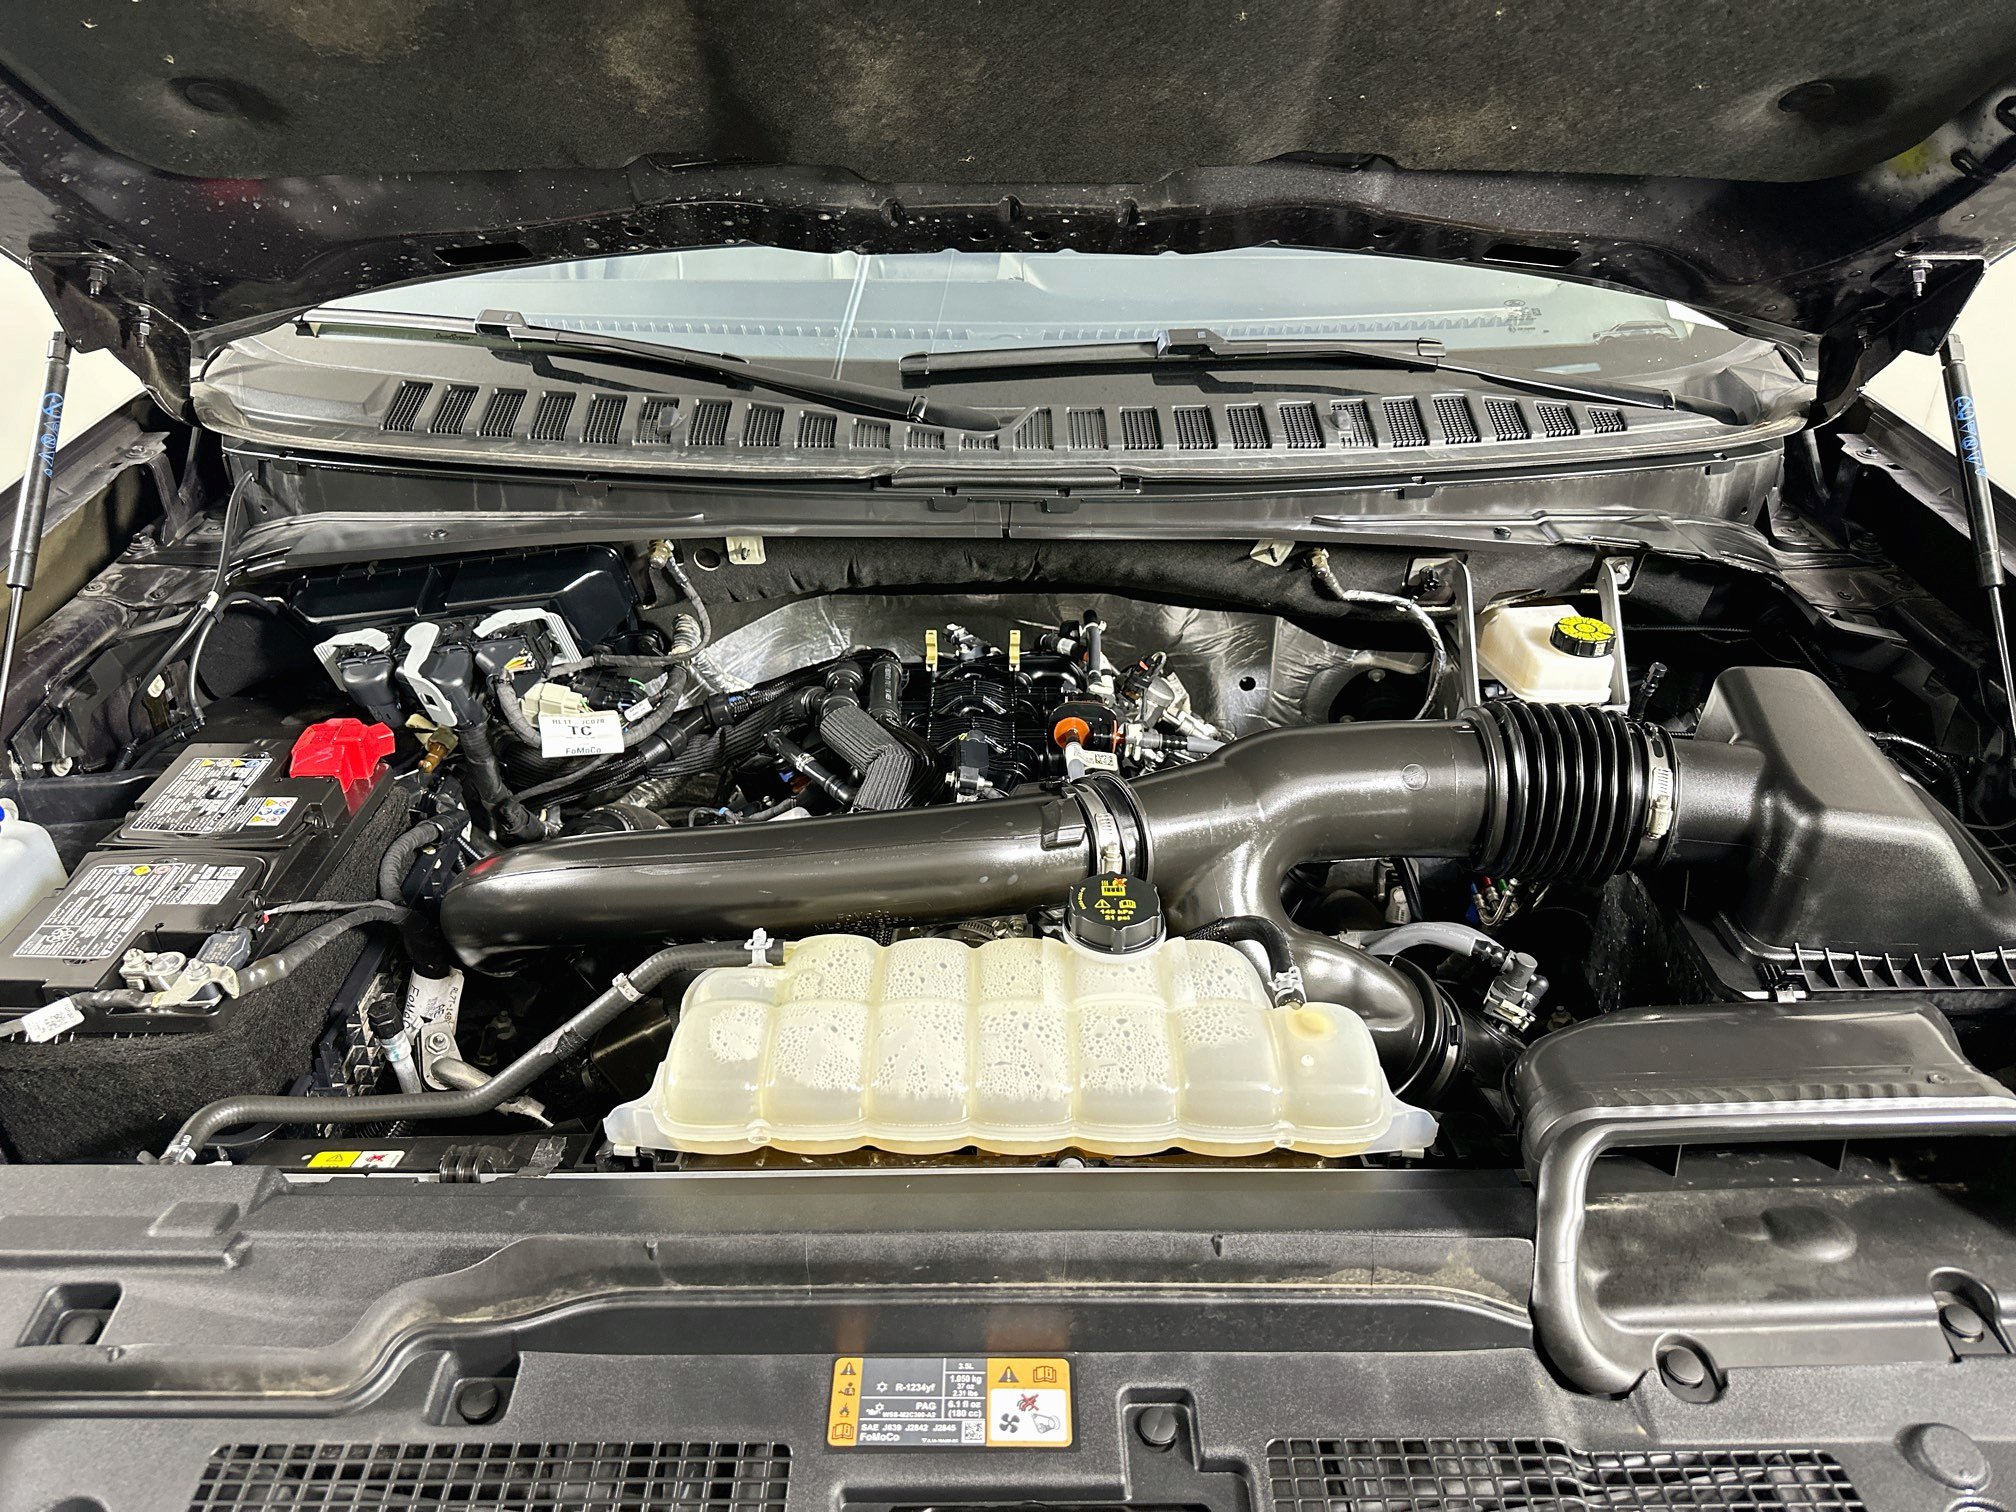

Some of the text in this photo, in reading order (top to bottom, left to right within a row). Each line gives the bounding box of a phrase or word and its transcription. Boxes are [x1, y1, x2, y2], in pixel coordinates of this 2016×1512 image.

[568, 725, 593, 736] TC
[403, 984, 420, 1029] FoMoC
[972, 1374, 982, 1384] kg
[895, 1383, 936, 1392] R-1234yf
[915, 1402, 936, 1410] PAG
[968, 1410, 982, 1418] cc)
[861, 1424, 880, 1432] SAE
[860, 1432, 900, 1442] FoMoCo
